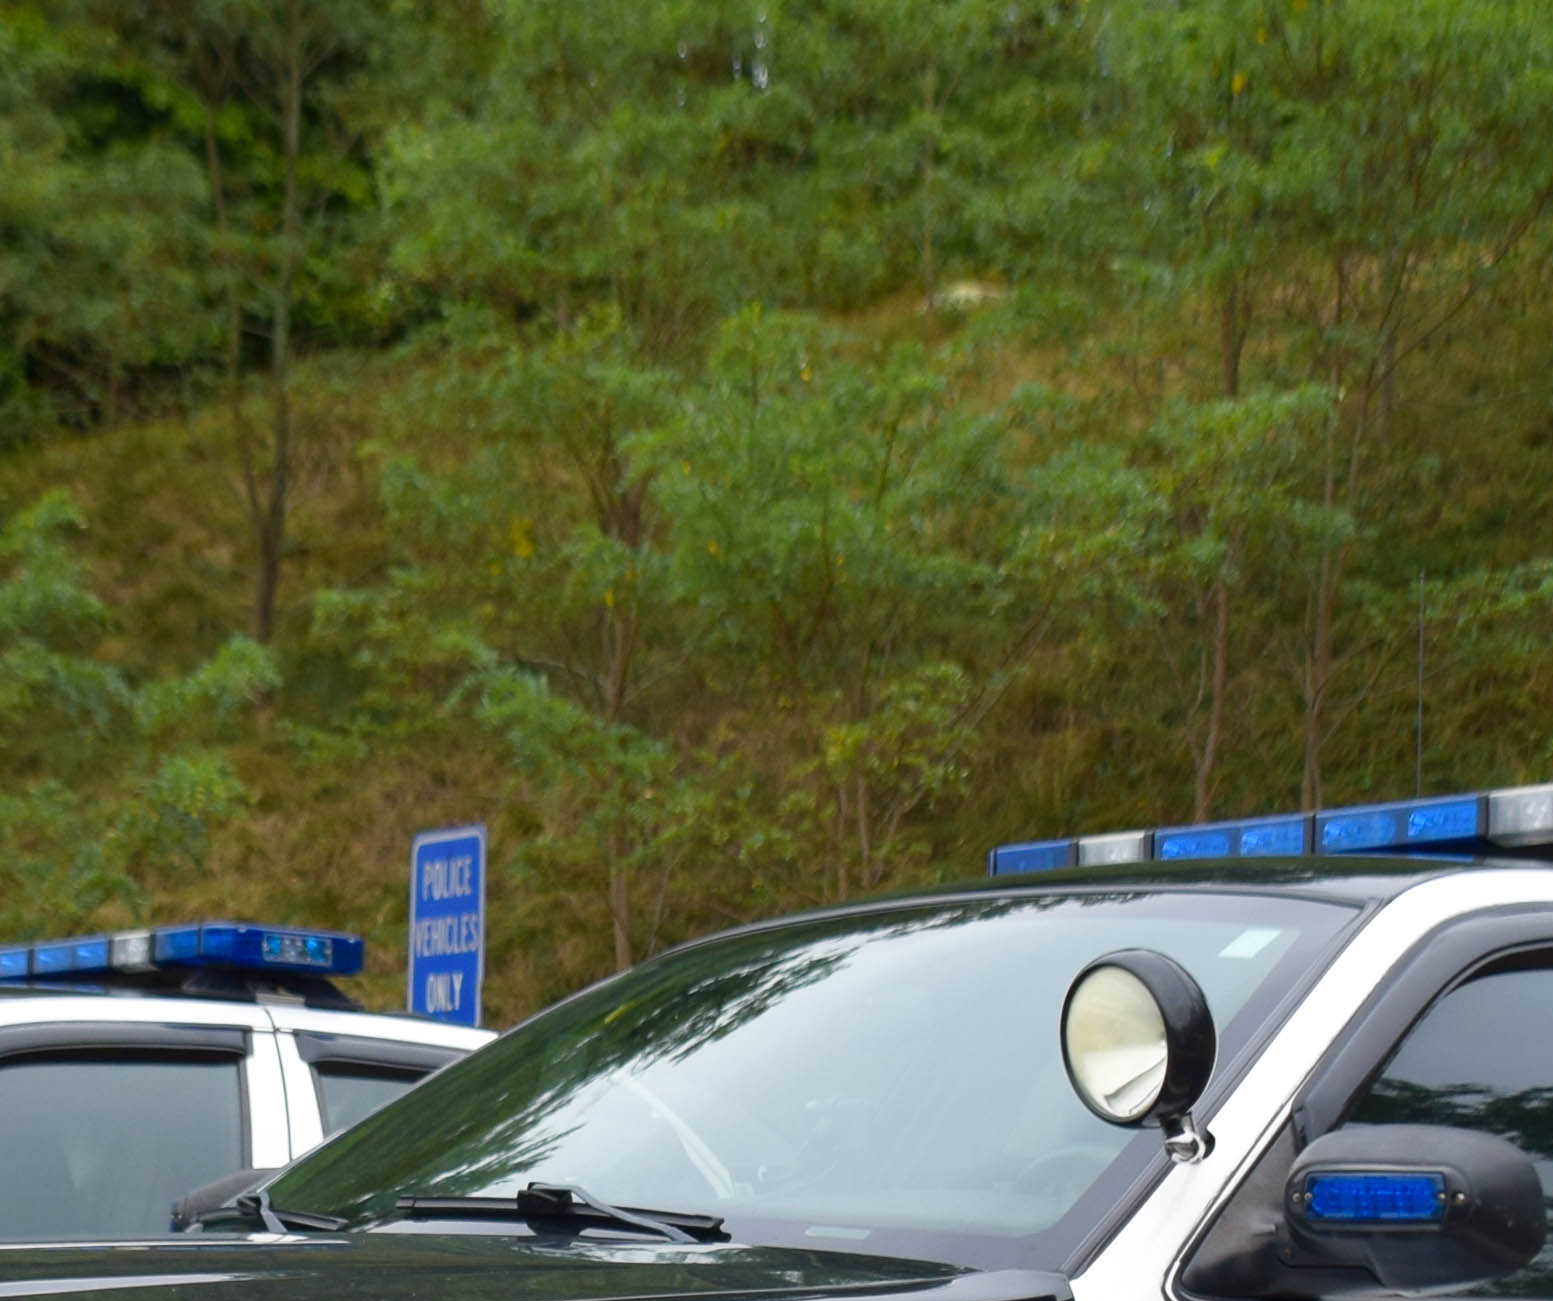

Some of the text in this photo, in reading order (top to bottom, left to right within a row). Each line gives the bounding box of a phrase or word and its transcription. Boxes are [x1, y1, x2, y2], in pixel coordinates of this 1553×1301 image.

[422, 856, 473, 902] POLICE
[415, 913, 479, 958] VEHICLES
[425, 971, 464, 1014] ONLY
